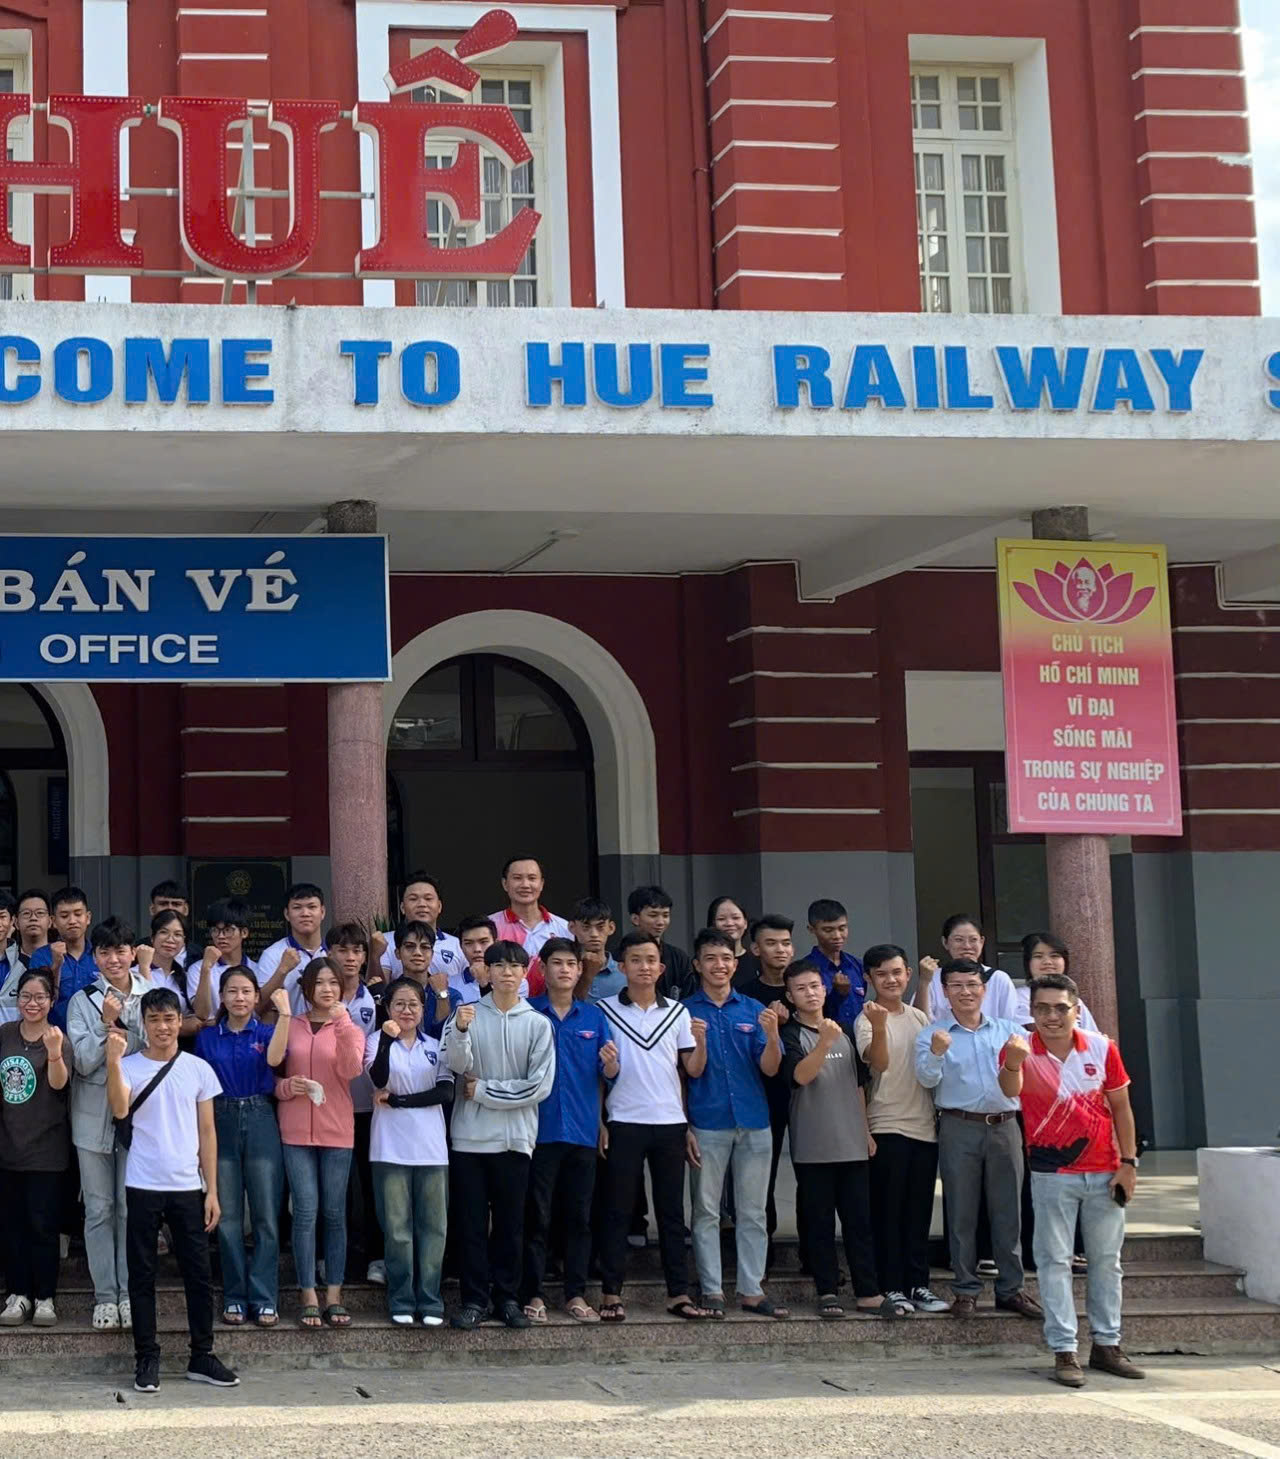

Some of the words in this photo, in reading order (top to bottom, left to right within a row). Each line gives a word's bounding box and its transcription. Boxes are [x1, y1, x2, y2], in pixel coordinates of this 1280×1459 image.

[340, 340, 461, 406] TO
[526, 342, 714, 408] HUE
[773, 344, 1205, 412] RAILWAY
[186, 551, 300, 612] VÉ
[40, 633, 220, 664] OFFICE
[1052, 630, 1082, 653] CHỦ
[1089, 636, 1124, 656] TỊCH
[1040, 661, 1060, 684] HỒ
[1066, 663, 1092, 684] CHÍ
[1098, 667, 1139, 686] MINH
[1068, 695, 1083, 715] VĨ
[1088, 698, 1114, 719] ĐẠI
[1053, 724, 1096, 748] SỐNG
[1102, 728, 1132, 748] MÃI
[1023, 760, 1075, 780] TRONG
[1081, 761, 1103, 784] SỰ
[1108, 759, 1165, 784] NGHIỆP
[1038, 787, 1070, 811] CỦA
[1075, 790, 1129, 812] CHÚNG
[1134, 794, 1154, 813] TA
